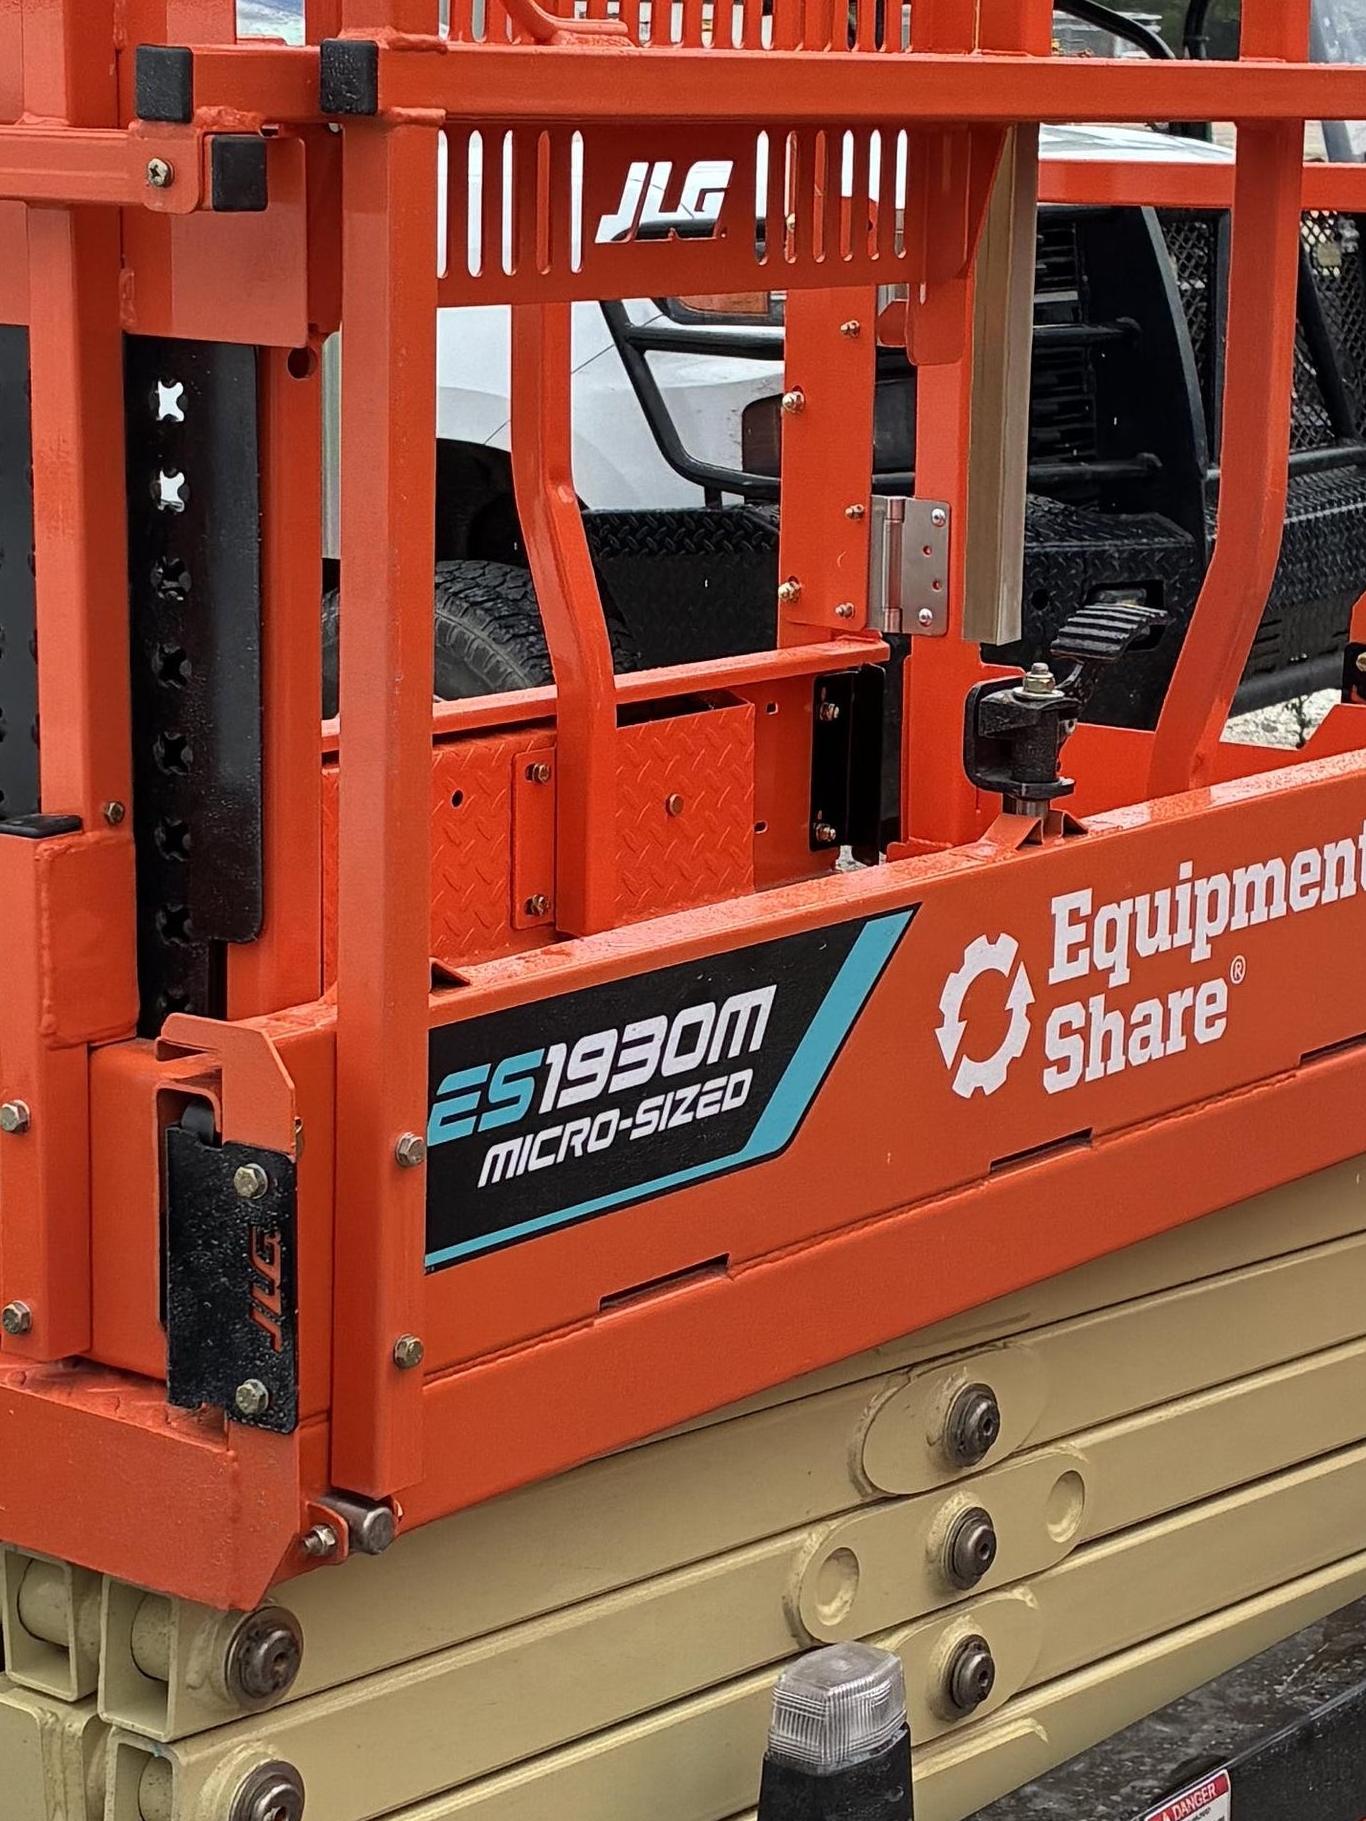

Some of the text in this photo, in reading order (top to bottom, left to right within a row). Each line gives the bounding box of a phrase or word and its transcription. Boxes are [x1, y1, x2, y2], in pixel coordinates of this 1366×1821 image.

[594, 160, 734, 244] JLG
[427, 985, 777, 1147] ES1930M
[477, 1067, 753, 1188] MICRO-SIZED
[249, 1226, 283, 1354] JLG
[1172, 1783, 1217, 1819] DANGER
